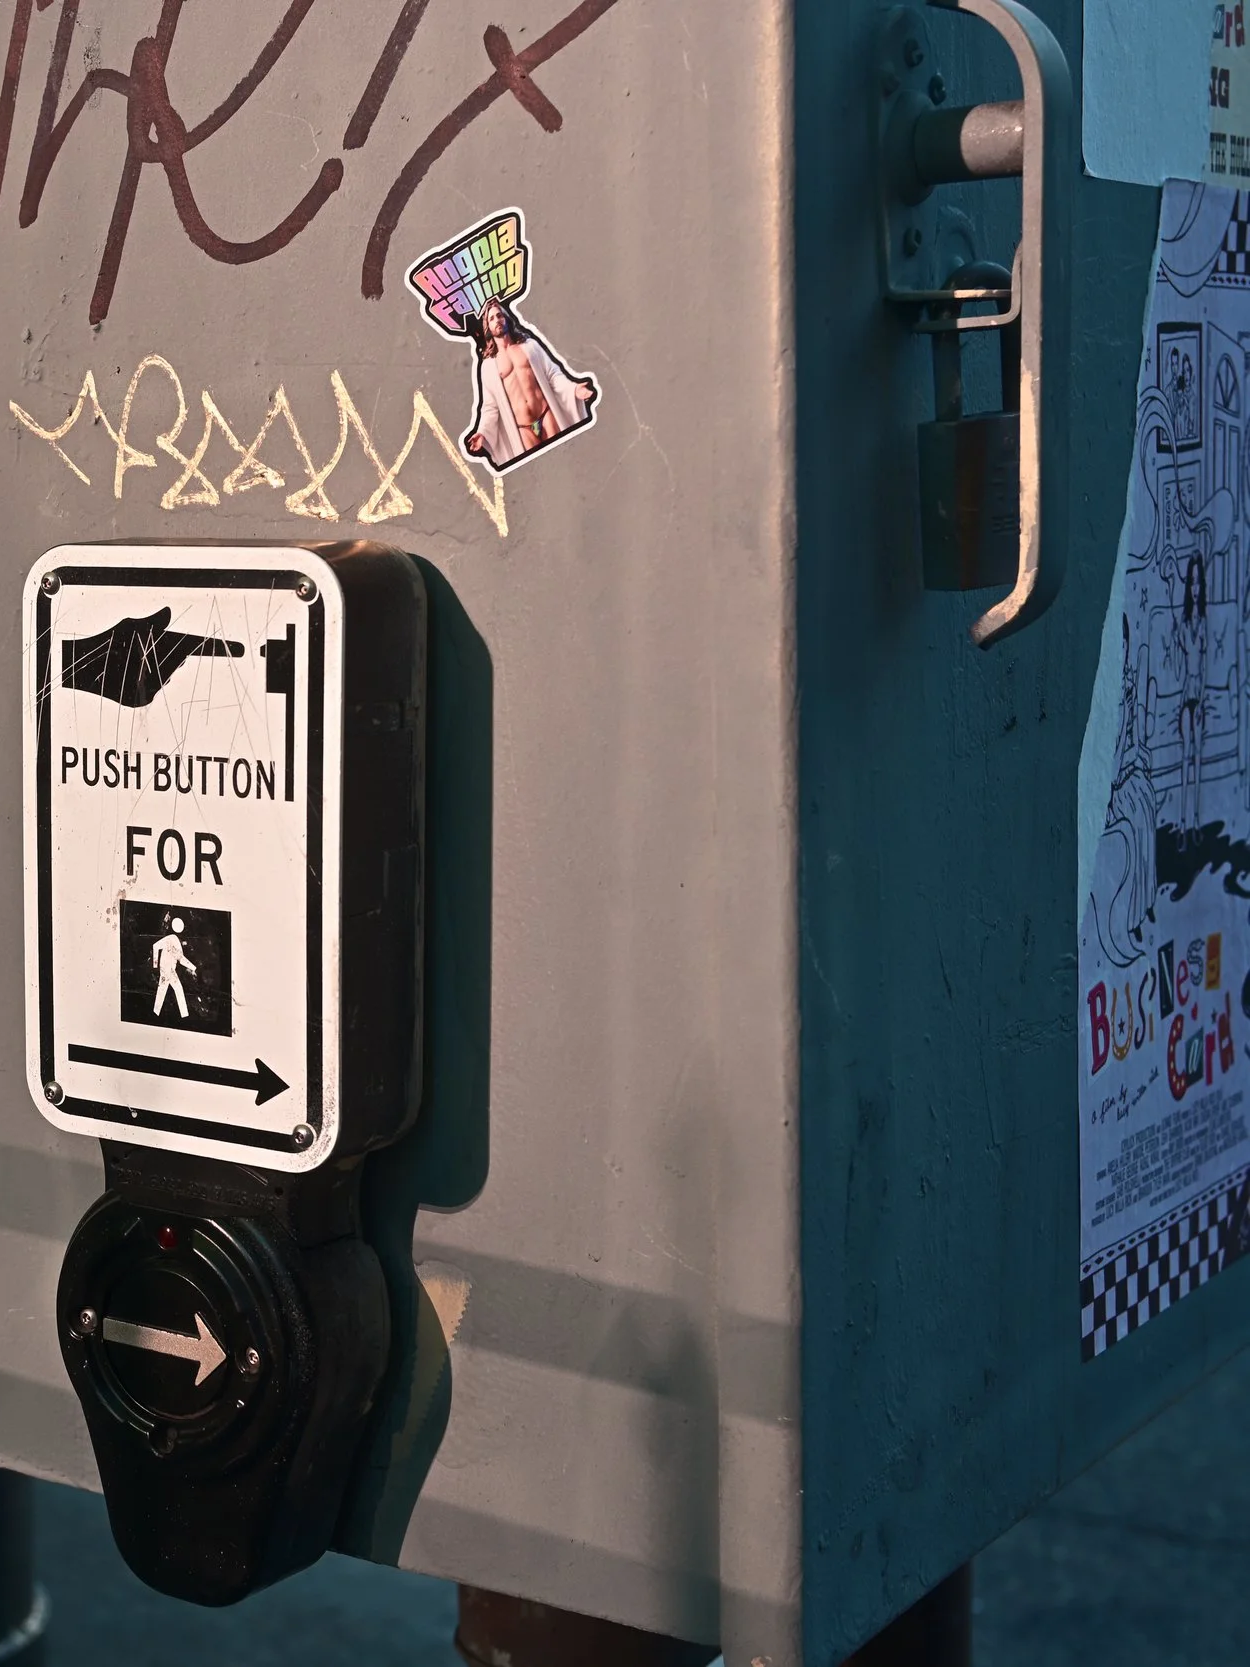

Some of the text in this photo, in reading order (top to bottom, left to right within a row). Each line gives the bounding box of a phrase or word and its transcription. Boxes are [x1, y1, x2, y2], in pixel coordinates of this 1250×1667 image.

[61, 745, 276, 801] PUSH BUTTON
[126, 825, 224, 886] FOR
